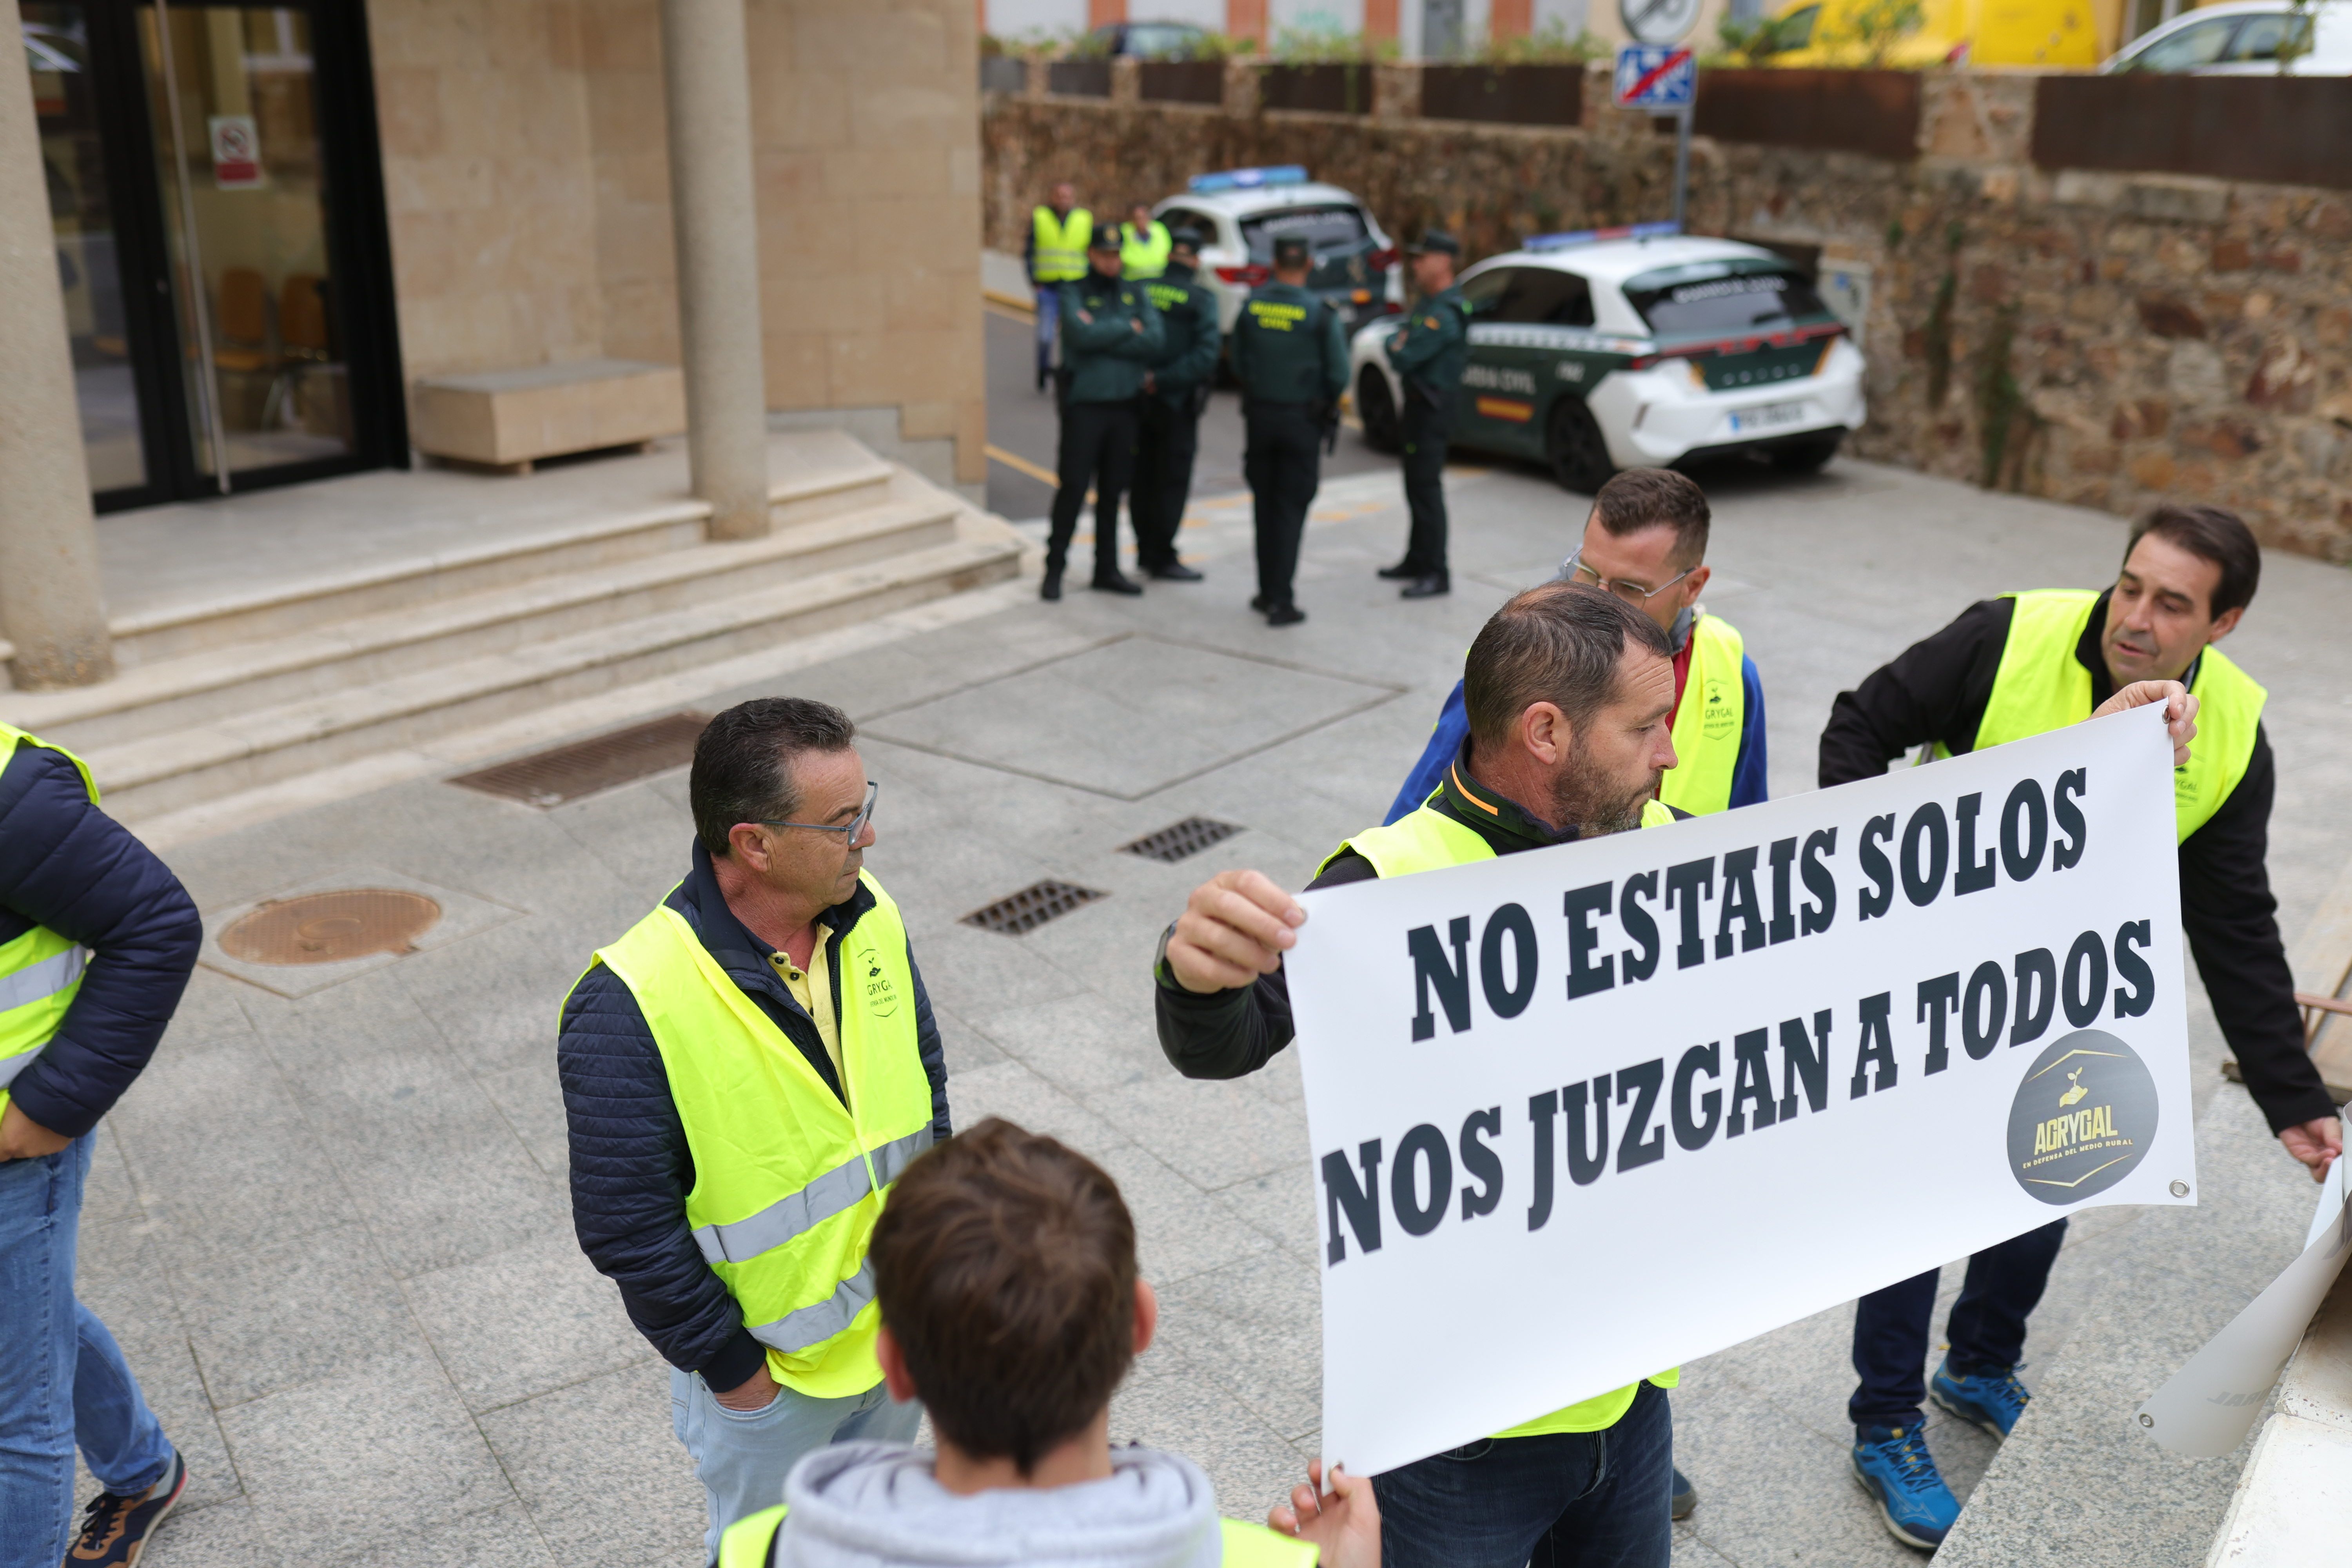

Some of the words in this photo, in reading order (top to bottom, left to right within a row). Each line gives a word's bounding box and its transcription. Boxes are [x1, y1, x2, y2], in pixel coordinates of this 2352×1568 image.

[1408, 903, 1538, 1042] NO
[1563, 827, 1838, 1000] ESTAIS
[1859, 767, 2086, 921] SOLOS
[1322, 1106, 1503, 1266] NOS
[1528, 1008, 1832, 1231] JUZGAN
[1851, 991, 1898, 1100] A
[1917, 919, 2155, 1076] TODOS
[2033, 1152, 2063, 1166] DEFENSA
[2065, 1148, 2078, 1156] DEL
[2080, 1142, 2103, 1152] MEDIO
[2105, 1139, 2133, 1147] RURAL
[2034, 1105, 2118, 1155] AGRYGAL
